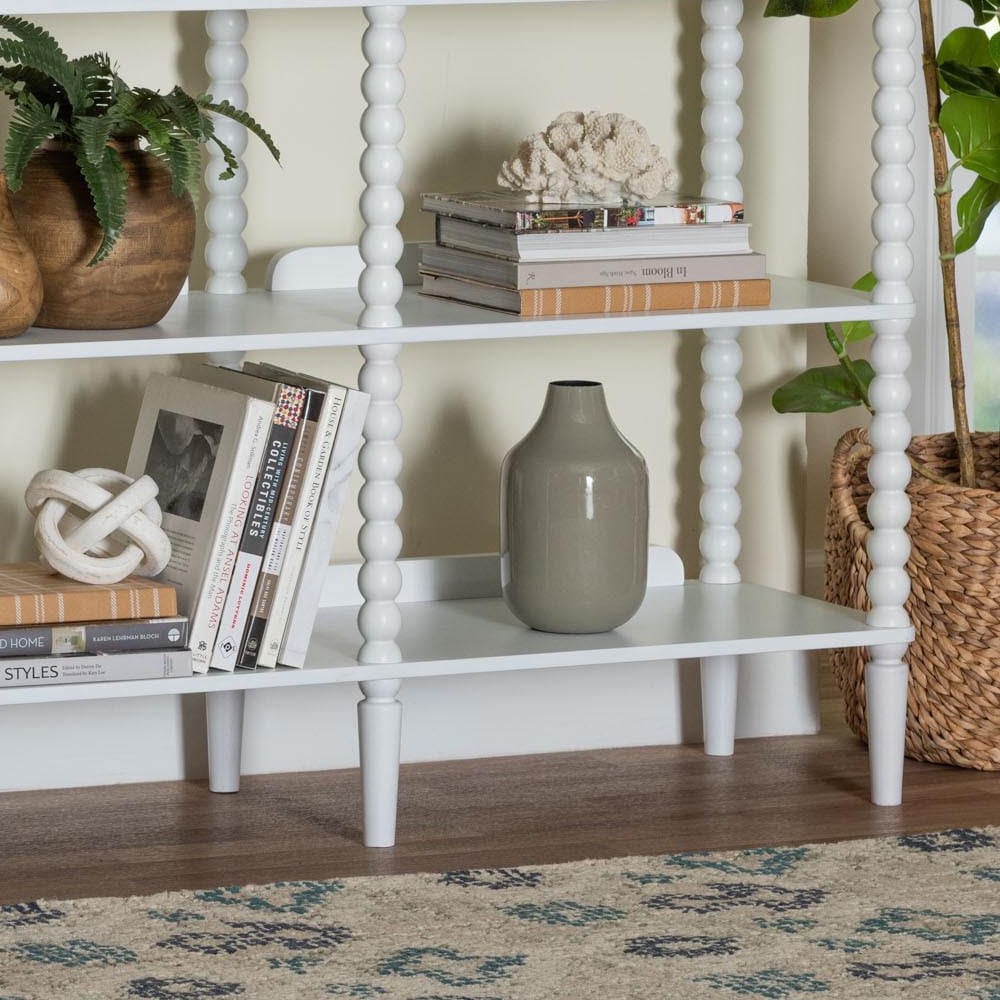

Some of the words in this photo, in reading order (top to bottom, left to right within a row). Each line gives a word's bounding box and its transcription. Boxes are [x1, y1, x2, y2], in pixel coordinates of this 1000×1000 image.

[642, 267, 674, 279] Bloom
[676, 266, 687, 277] In
[326, 396, 342, 428] HOUSE
[324, 429, 332, 438] &
[276, 441, 288, 466] LIVING
[313, 440, 330, 480] GARDEN
[248, 439, 282, 537] COLLECTIBLES
[271, 468, 281, 488] WITH
[232, 474, 254, 528] LOOKING
[305, 481, 319, 509] BOOK
[228, 502, 237, 515] The
[258, 488, 276, 538] MID-CENTURY
[216, 515, 233, 556] Photographs
[228, 530, 240, 545] AT
[213, 556, 223, 570] and
[218, 548, 235, 584] ANSEL
[210, 570, 219, 583] the
[238, 562, 251, 595] DOMINIC
[206, 582, 215, 599] Man
[206, 586, 225, 630] ADAMS
[10, 636, 45, 648] HOME
[4, 665, 59, 681] STYLES
